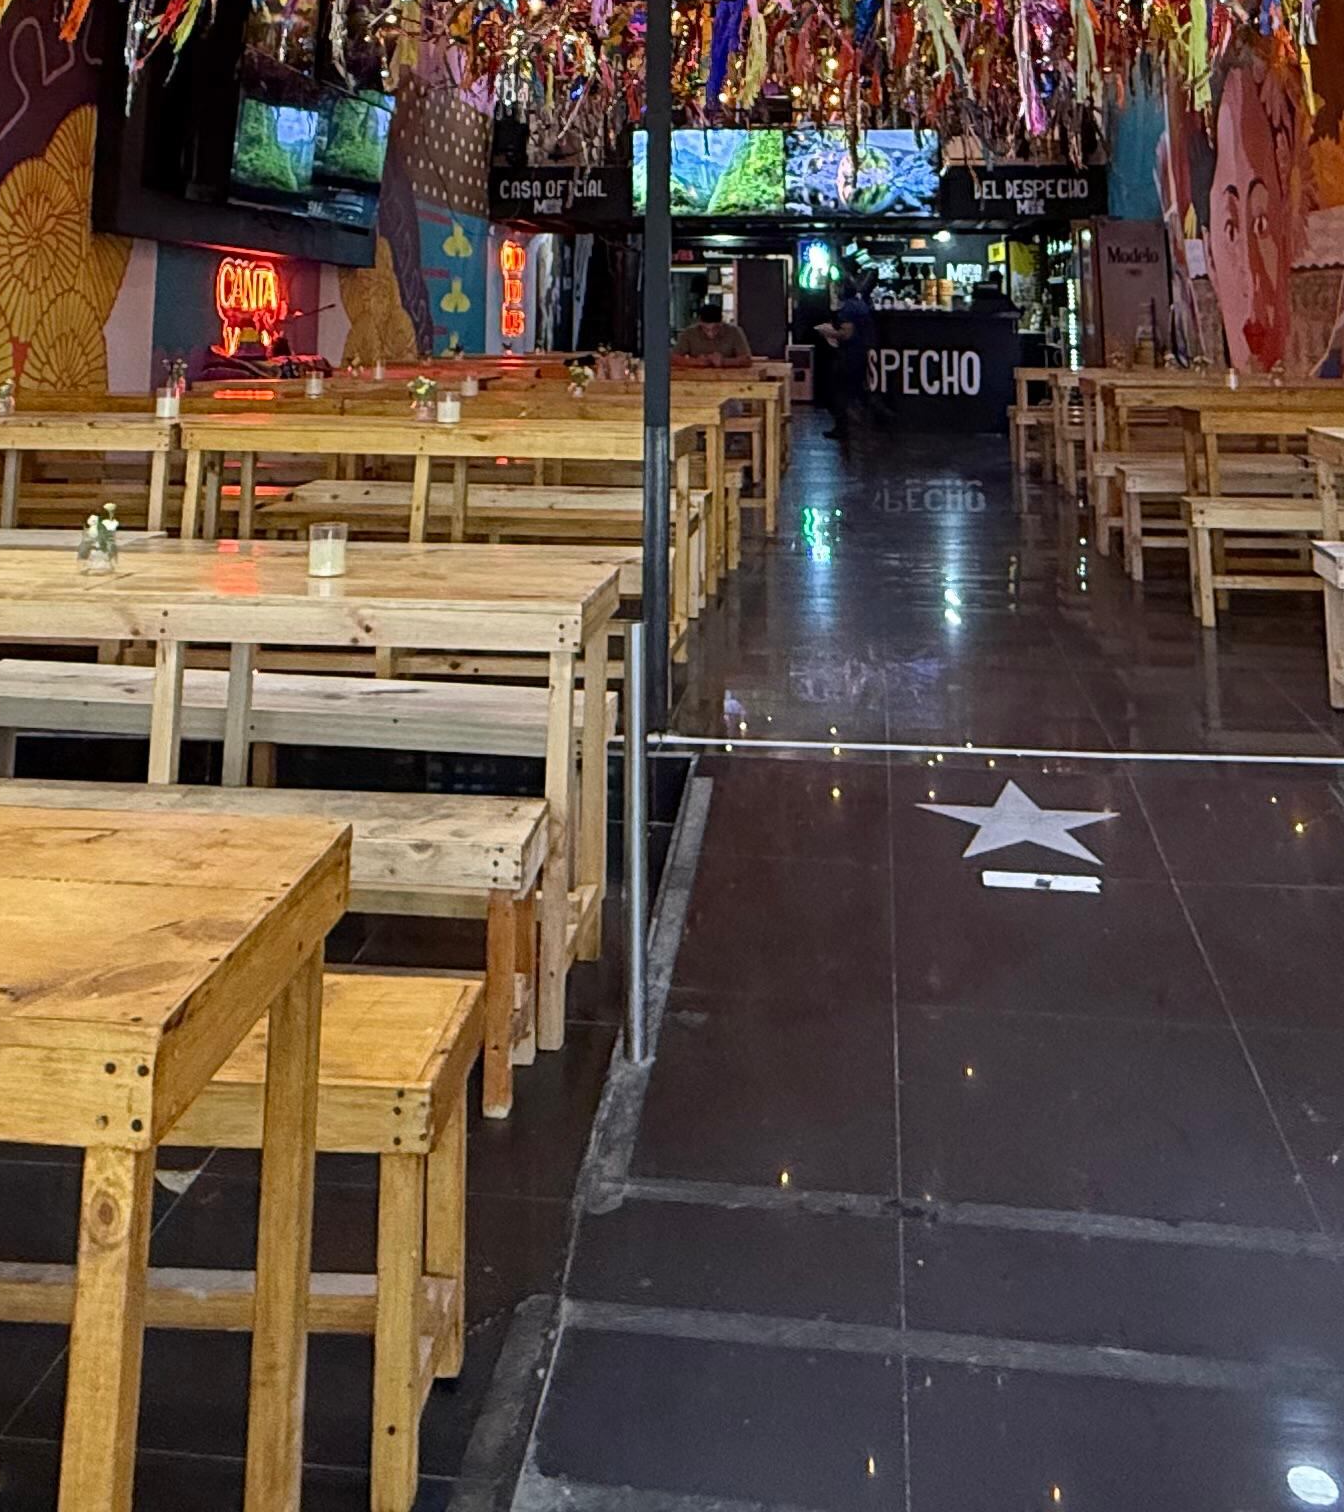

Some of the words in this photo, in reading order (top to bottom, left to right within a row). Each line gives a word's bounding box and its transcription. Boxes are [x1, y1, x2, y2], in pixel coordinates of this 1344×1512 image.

[499, 180, 542, 199] CASA
[545, 179, 607, 197] OFICIAL
[973, 180, 1002, 199] DEL
[1005, 178, 1089, 199] DESPECHO
[1107, 246, 1159, 264] Modelo
[220, 263, 278, 311] CANTA
